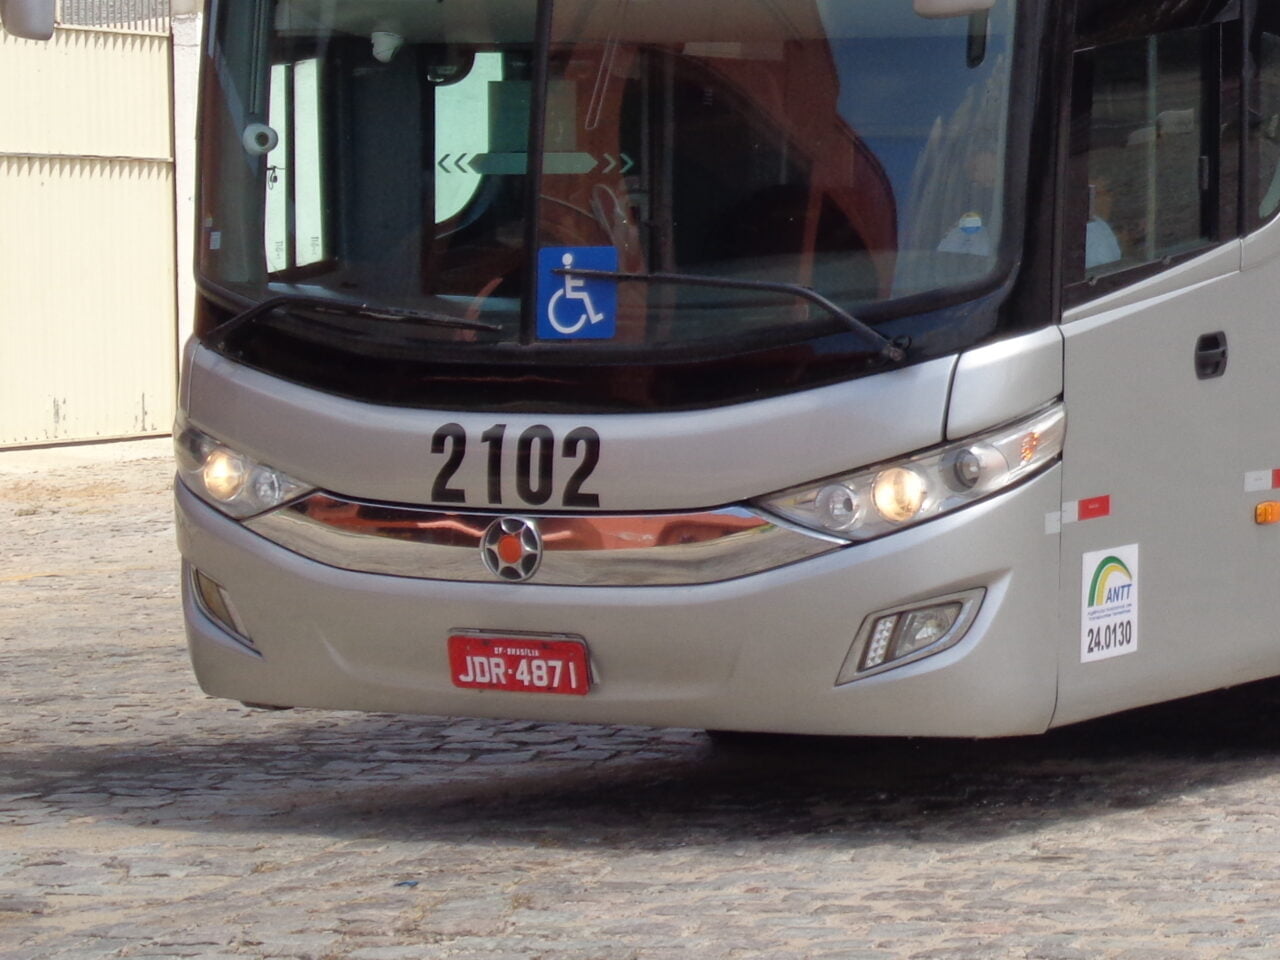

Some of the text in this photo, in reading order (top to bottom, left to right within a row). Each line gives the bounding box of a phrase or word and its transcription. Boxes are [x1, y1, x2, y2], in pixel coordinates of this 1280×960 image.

[431, 423, 600, 507] 2102
[1105, 583, 1132, 604] ANTT
[1087, 620, 1132, 653] 24.0130
